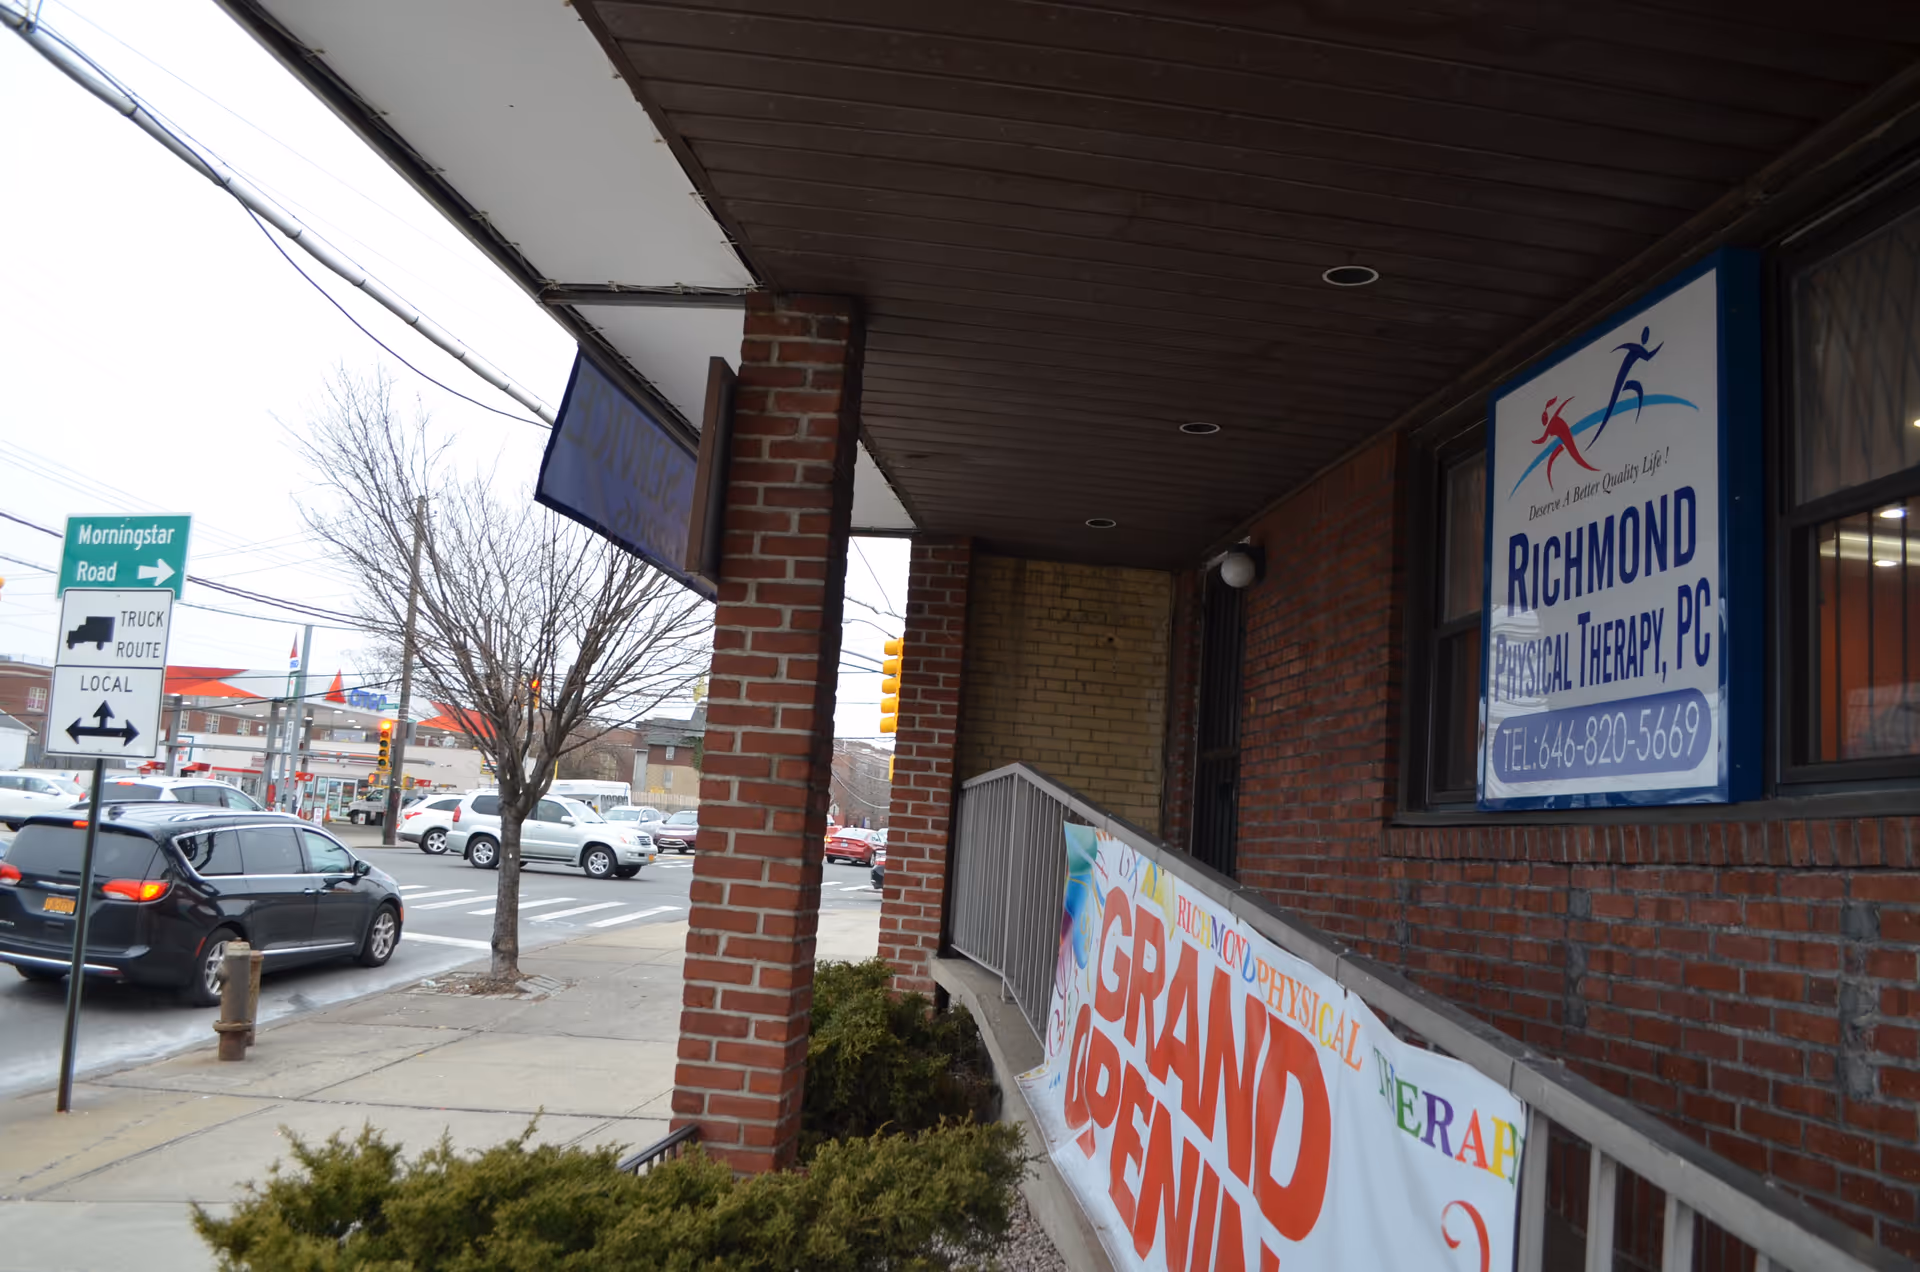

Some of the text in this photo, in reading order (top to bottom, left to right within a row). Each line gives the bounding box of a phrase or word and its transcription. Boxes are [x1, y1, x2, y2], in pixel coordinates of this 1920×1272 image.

[1529, 500, 1560, 521] Deserve
[1562, 490, 1570, 508] A
[1573, 481, 1600, 503] Better
[1602, 463, 1639, 494] Quality
[78, 524, 175, 550] Morningstar
[1507, 485, 1696, 617] RICHMOND
[76, 560, 117, 582] Road
[120, 611, 164, 628] TRUCK
[1494, 632, 1572, 702] PHYSICAL
[1676, 577, 1711, 671] PC
[116, 641, 161, 658] ROUTE
[80, 675, 133, 693] LOCAL
[1177, 895, 1256, 983] RICHMOND
[1255, 957, 1362, 1072] PHYSICAL
[1095, 886, 1331, 1241] GRAND
